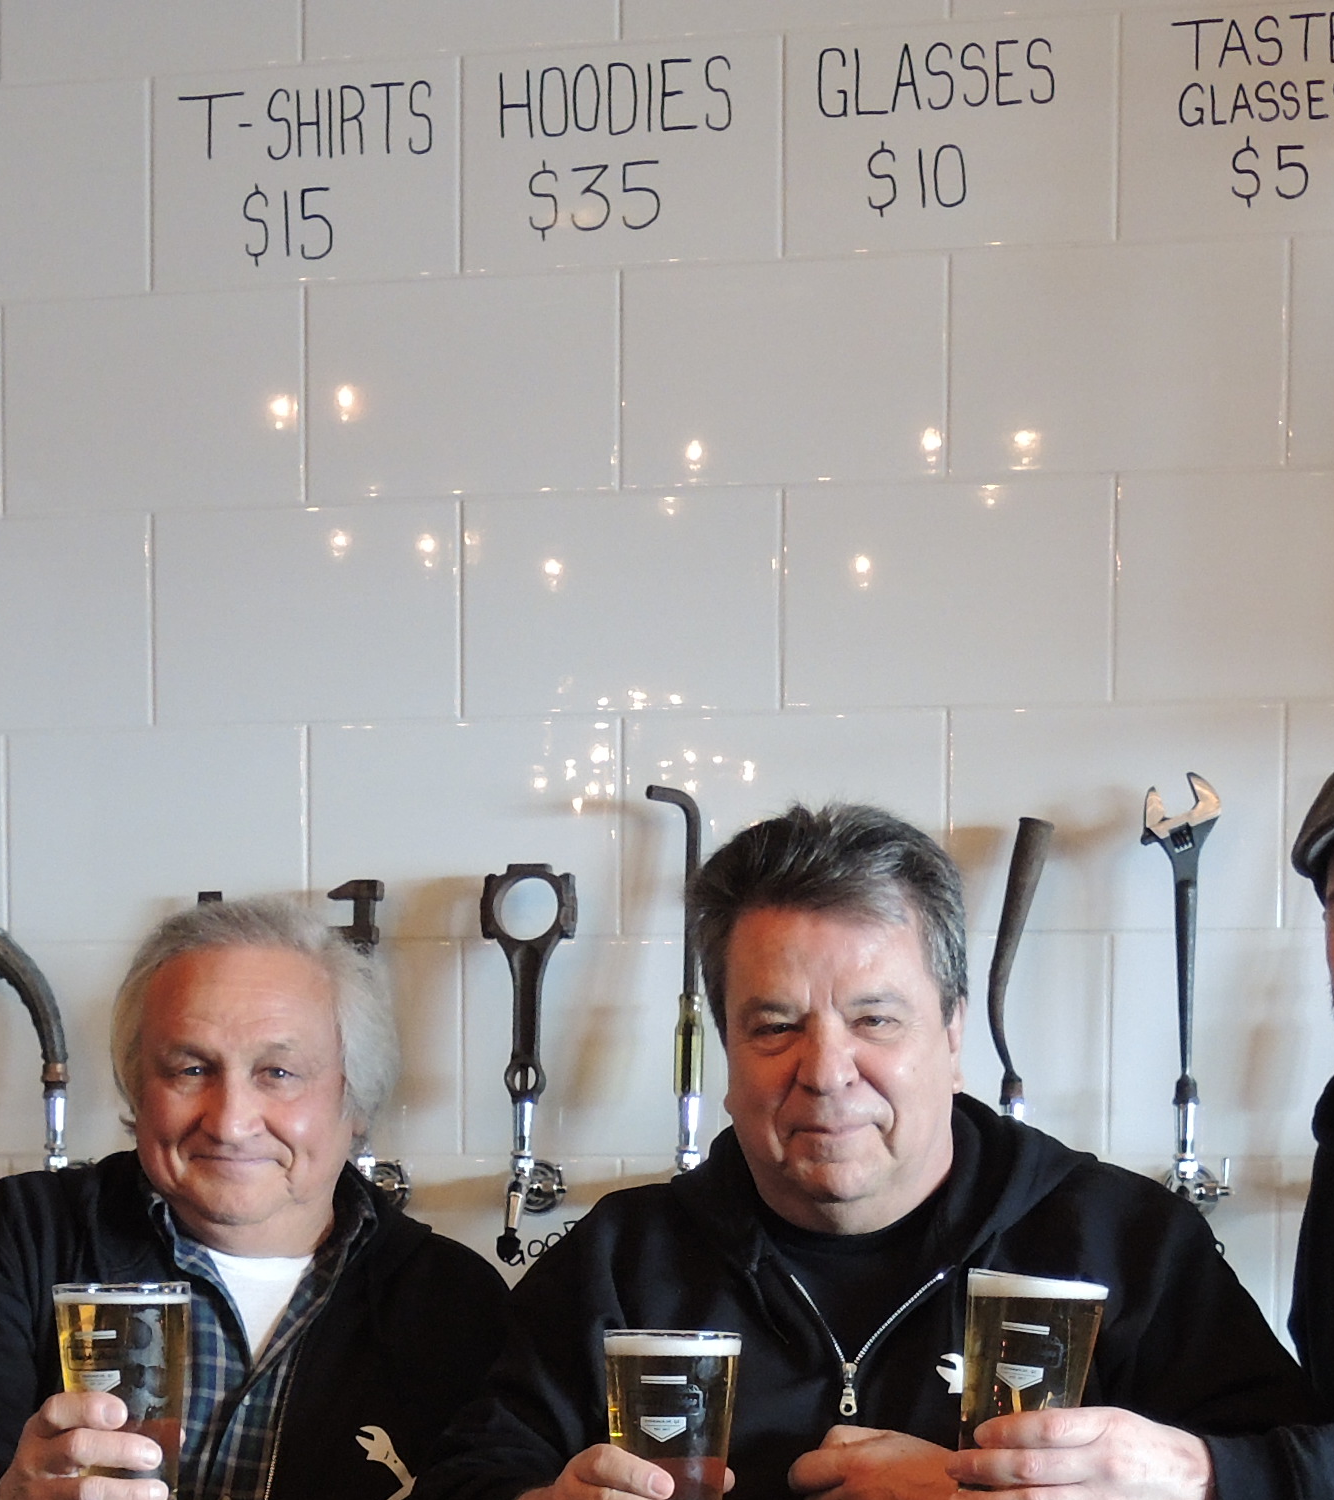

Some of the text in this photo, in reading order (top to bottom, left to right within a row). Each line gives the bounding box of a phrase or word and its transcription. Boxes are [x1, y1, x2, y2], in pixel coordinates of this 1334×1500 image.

[499, 55, 733, 140] HOODIES
[817, 38, 1057, 118] GLASSES
[178, 81, 434, 160] T-SHIRTS
[527, 160, 662, 242] $35
[867, 140, 968, 217] $10
[1231, 136, 1311, 208] $5
[243, 184, 334, 266] $15
